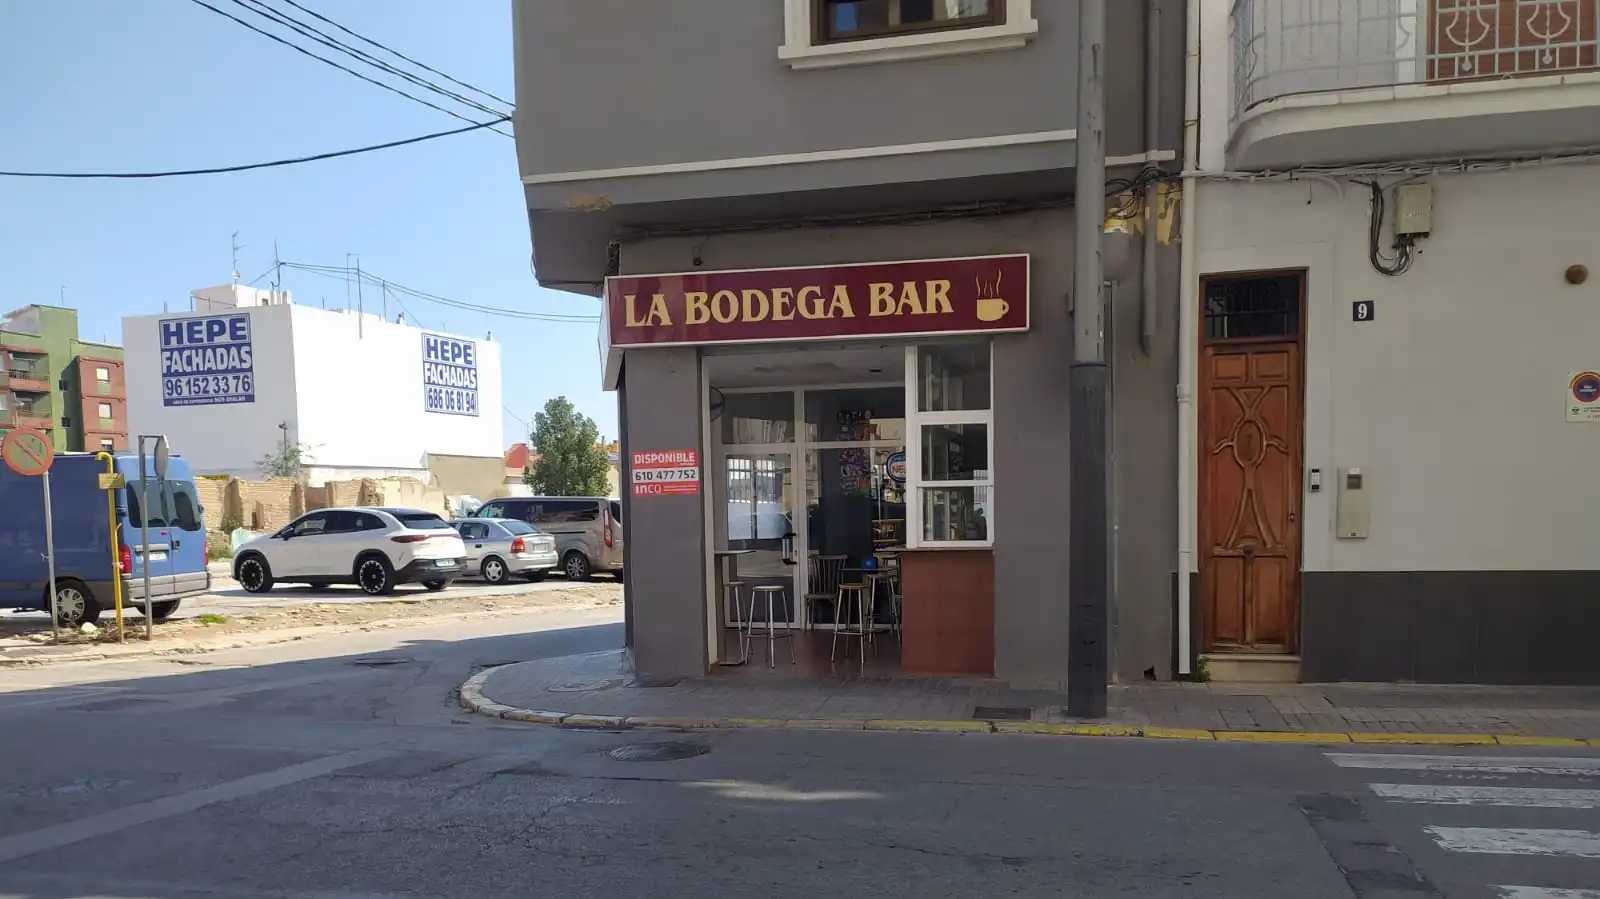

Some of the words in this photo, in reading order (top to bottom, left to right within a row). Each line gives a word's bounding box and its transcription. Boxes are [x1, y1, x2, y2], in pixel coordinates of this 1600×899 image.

[624, 293, 673, 327] LA
[684, 284, 855, 325] BODEGA
[868, 279, 954, 316] BAR
[1358, 303, 1368, 320] 9
[163, 318, 247, 345] HEPE
[161, 345, 252, 374] FACHADAS
[426, 338, 472, 365] HEPE
[165, 379, 183, 397] 96
[185, 377, 210, 395] 152
[211, 376, 230, 394] 33
[232, 374, 251, 393] 76
[424, 362, 477, 389] FACHADAS
[428, 387, 443, 410] 686
[445, 389, 455, 411] 06
[456, 390, 464, 412] 81
[465, 391, 475, 413] 94
[634, 452, 695, 464] DISPONIBLE
[635, 471, 653, 481] 610
[656, 470, 674, 480] 477
[677, 469, 696, 479] 752
